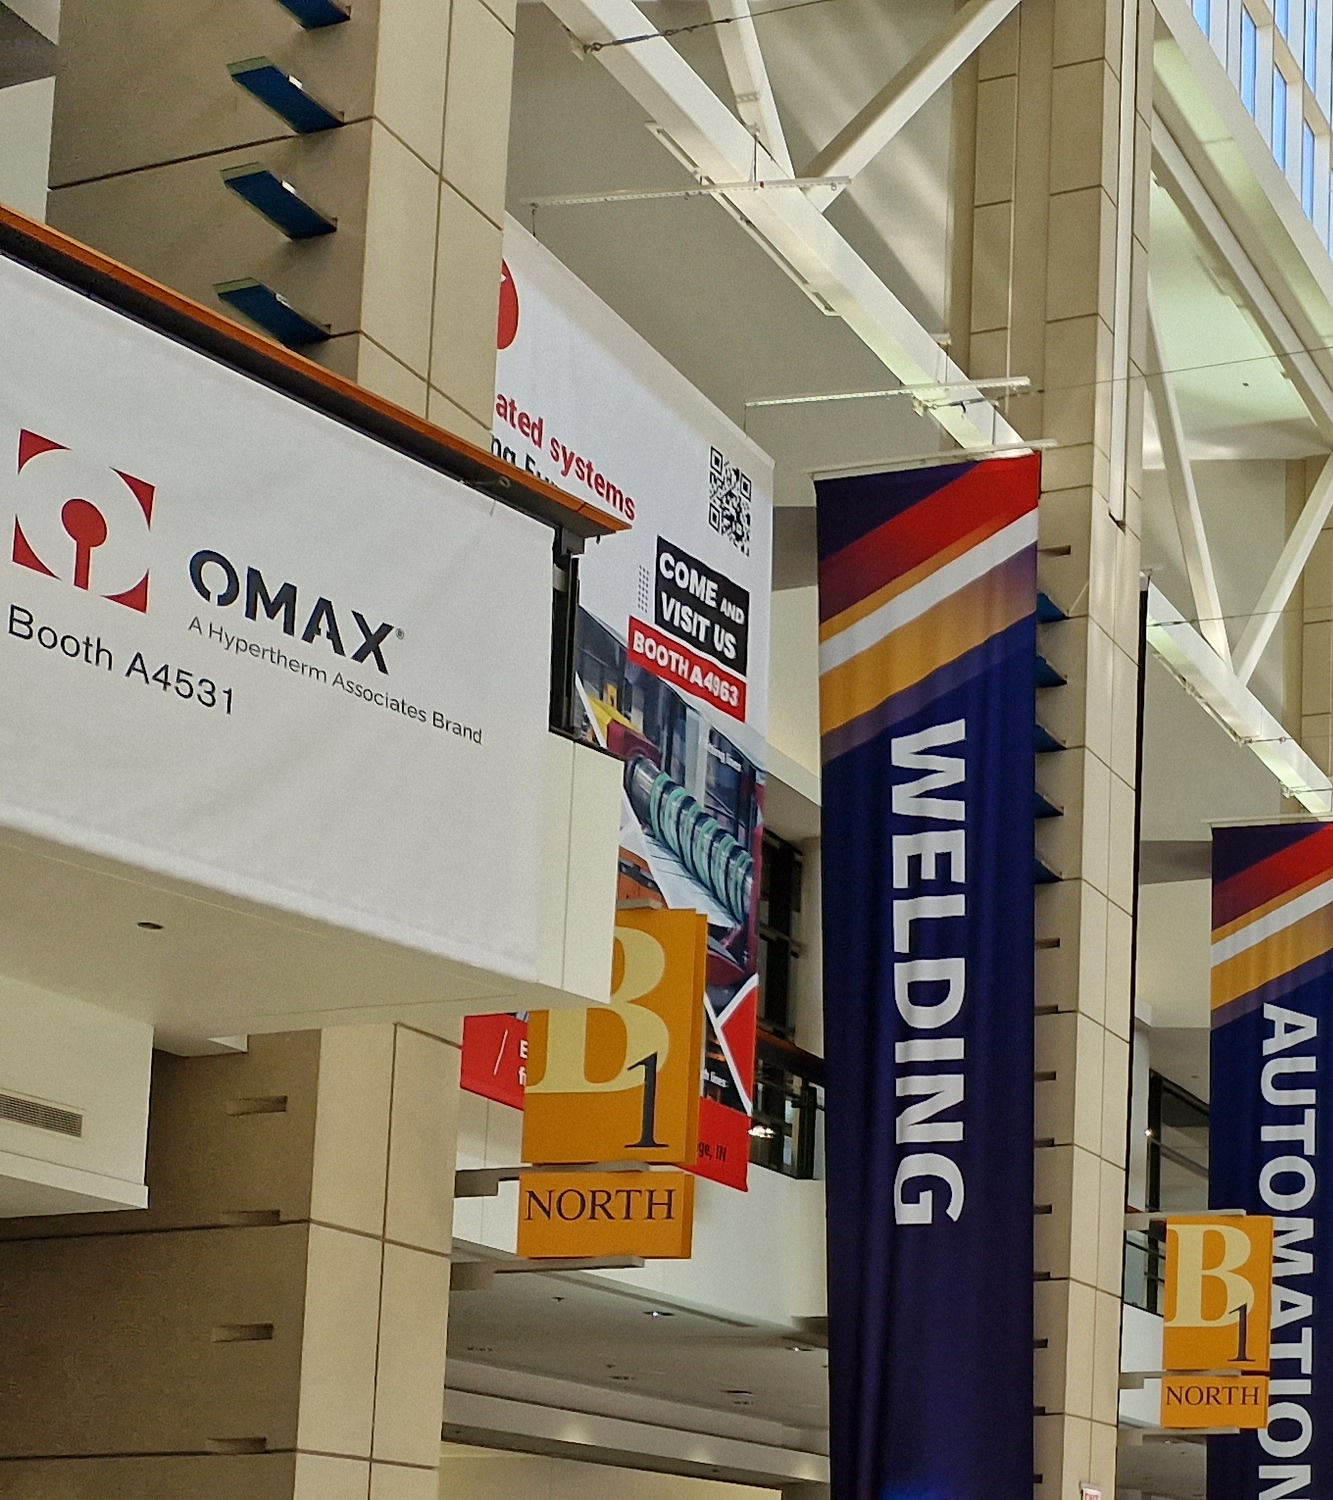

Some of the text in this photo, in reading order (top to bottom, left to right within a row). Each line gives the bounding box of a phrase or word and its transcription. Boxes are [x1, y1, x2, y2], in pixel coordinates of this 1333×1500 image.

[550, 437, 636, 521] systems
[659, 552, 745, 626] COME AND
[661, 591, 737, 661] VISIT US
[8, 604, 235, 715] Booth A4531
[188, 616, 484, 745] A Hypertherm Associates Brand
[633, 630, 740, 707] BOOTH A4963
[891, 718, 967, 1226] WELDING
[524, 1188, 676, 1223] NORTH
[1165, 1384, 1261, 1408] NORTH
